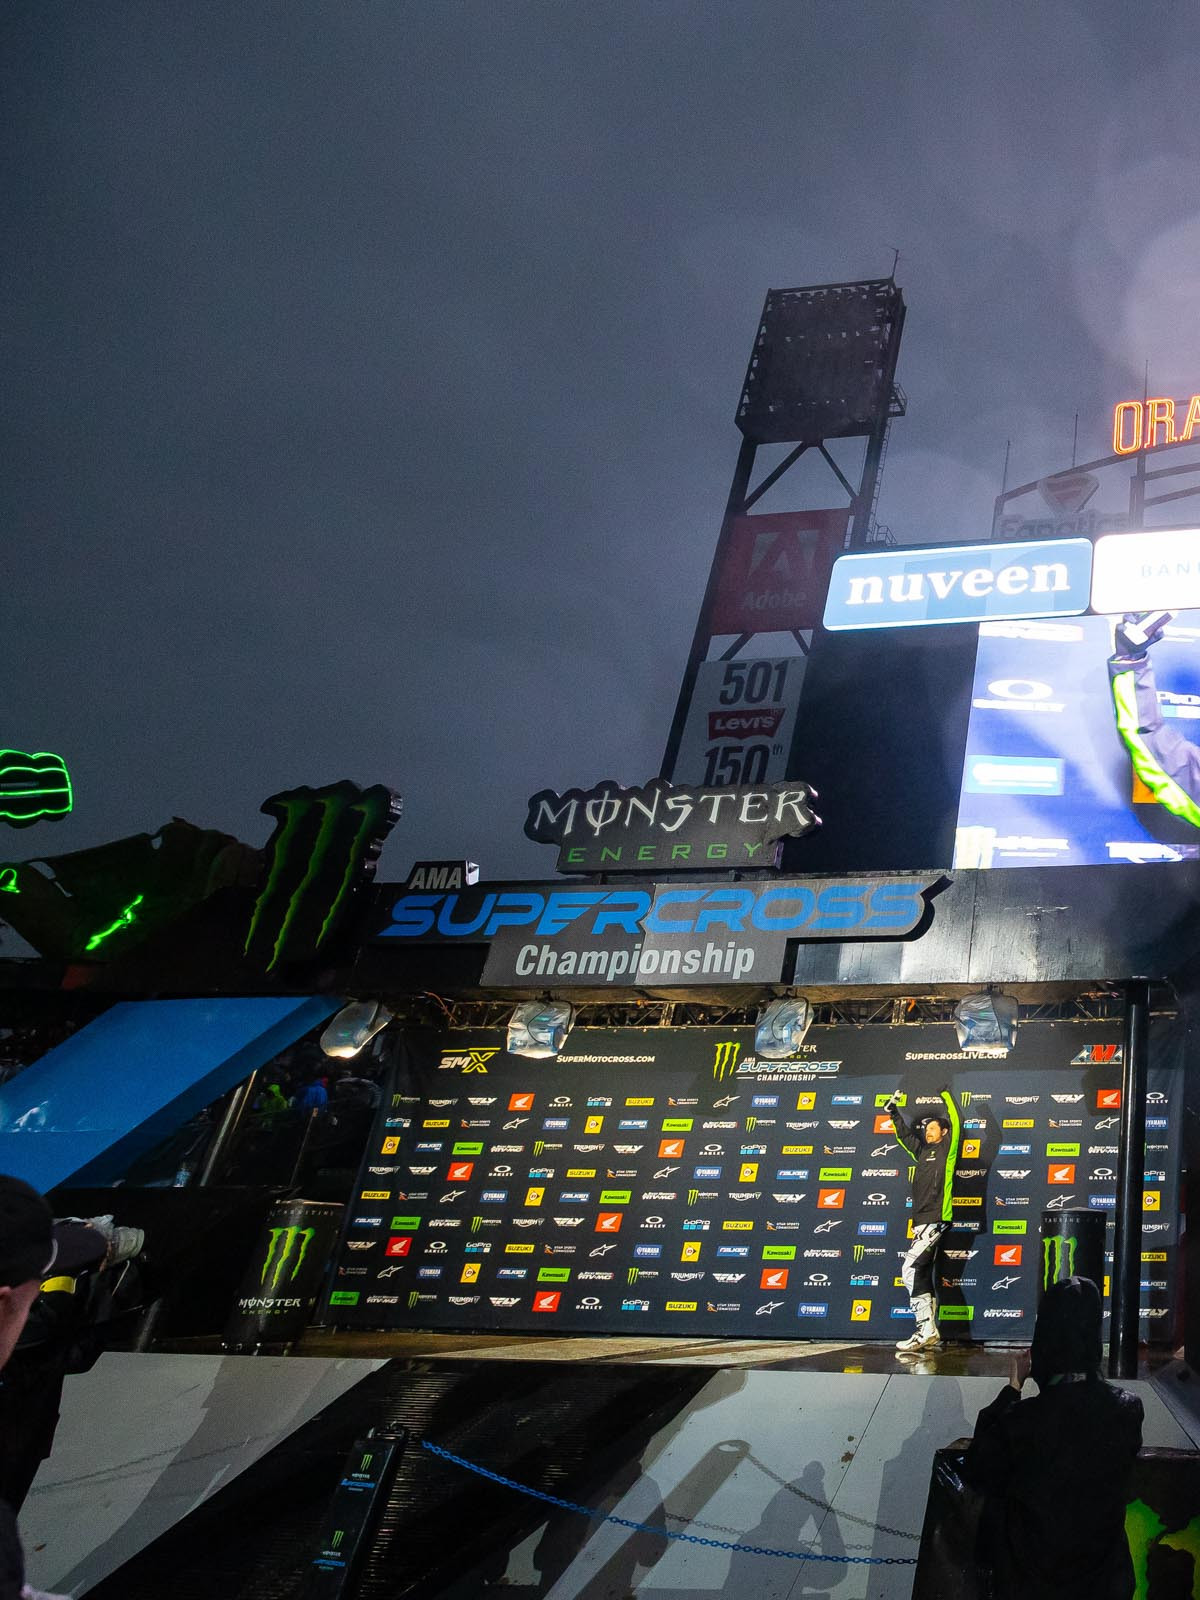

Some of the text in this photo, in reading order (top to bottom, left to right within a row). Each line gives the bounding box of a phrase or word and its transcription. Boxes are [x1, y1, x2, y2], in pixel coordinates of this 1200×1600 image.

[844, 562, 1072, 606] nuveen
[718, 660, 787, 706] 501
[533, 786, 814, 837] MONSTER
[567, 842, 765, 864] ENERGY
[409, 868, 463, 890] AMA
[378, 884, 925, 937] SUPERCROSS
[514, 940, 756, 981] Championship
[438, 1052, 496, 1073] SMX
[735, 1061, 843, 1073] SUPERCROSS
[238, 1296, 302, 1309] MONSTER
